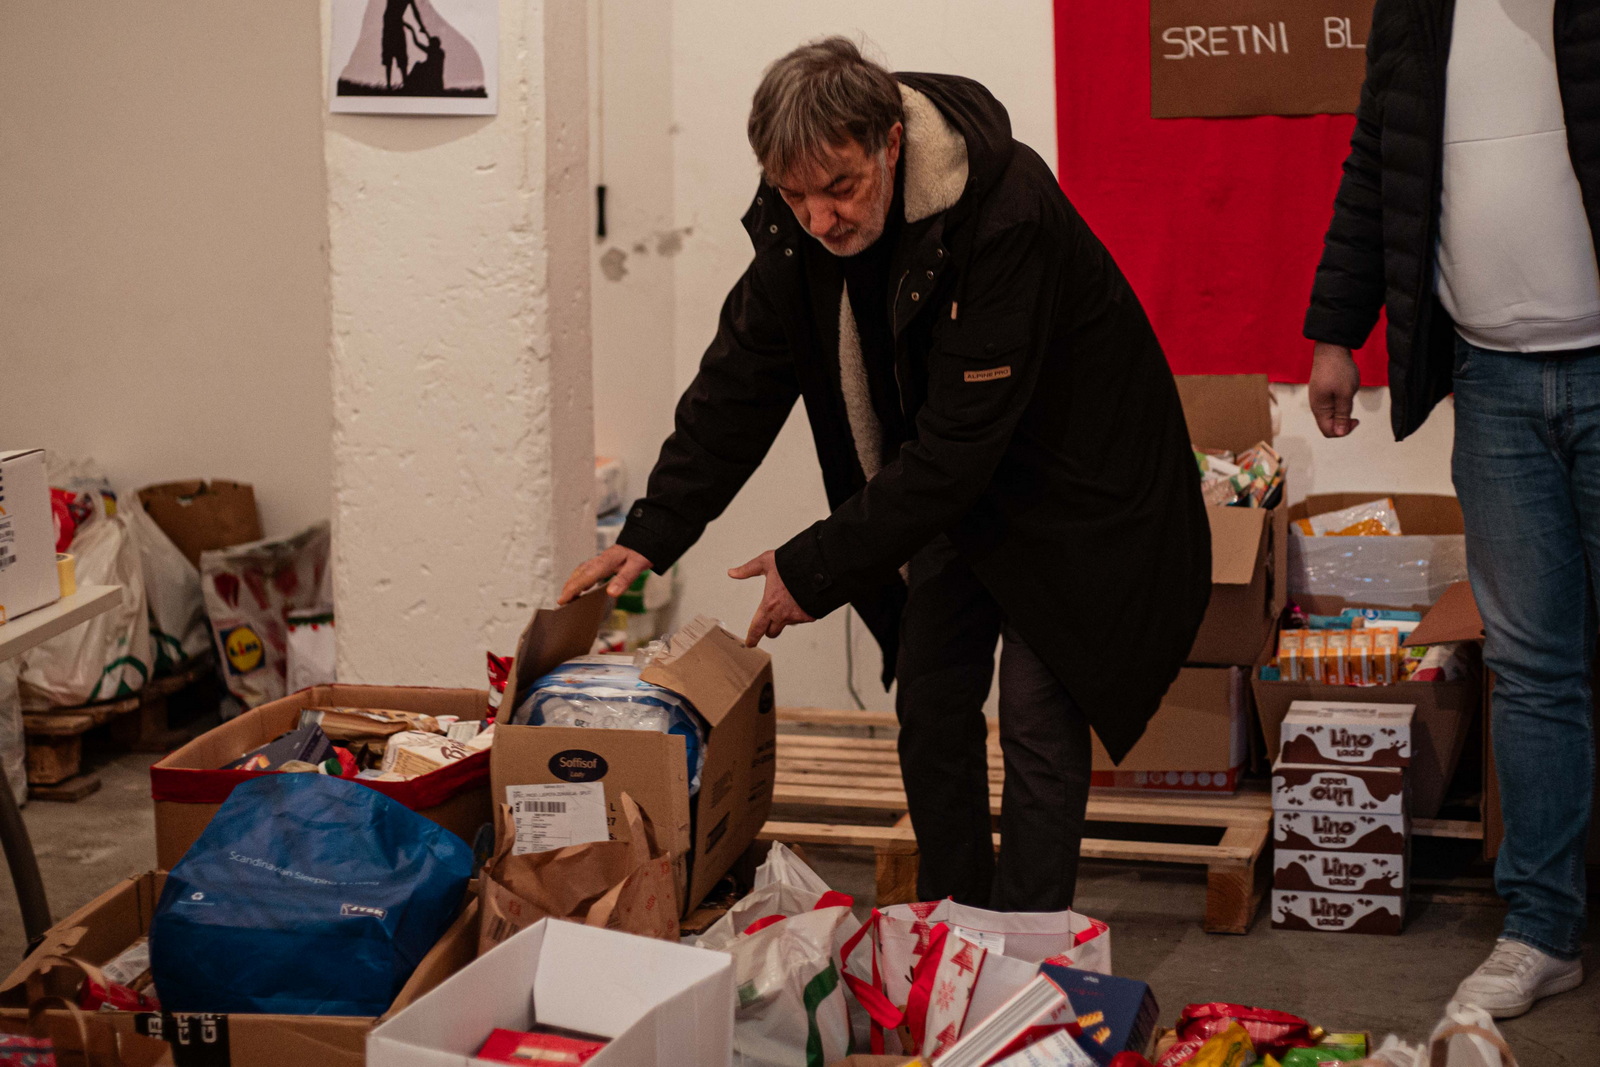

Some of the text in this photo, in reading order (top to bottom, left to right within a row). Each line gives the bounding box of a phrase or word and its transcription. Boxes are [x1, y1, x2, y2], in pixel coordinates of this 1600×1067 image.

[1162, 21, 1289, 60] SRETNI
[1329, 728, 1374, 748] Lino
[1310, 786, 1354, 807] Lino
[1311, 815, 1356, 835] Lino
[229, 850, 293, 877] Scandinavian
[1321, 857, 1366, 878] Lino
[1310, 897, 1354, 918] Lino
